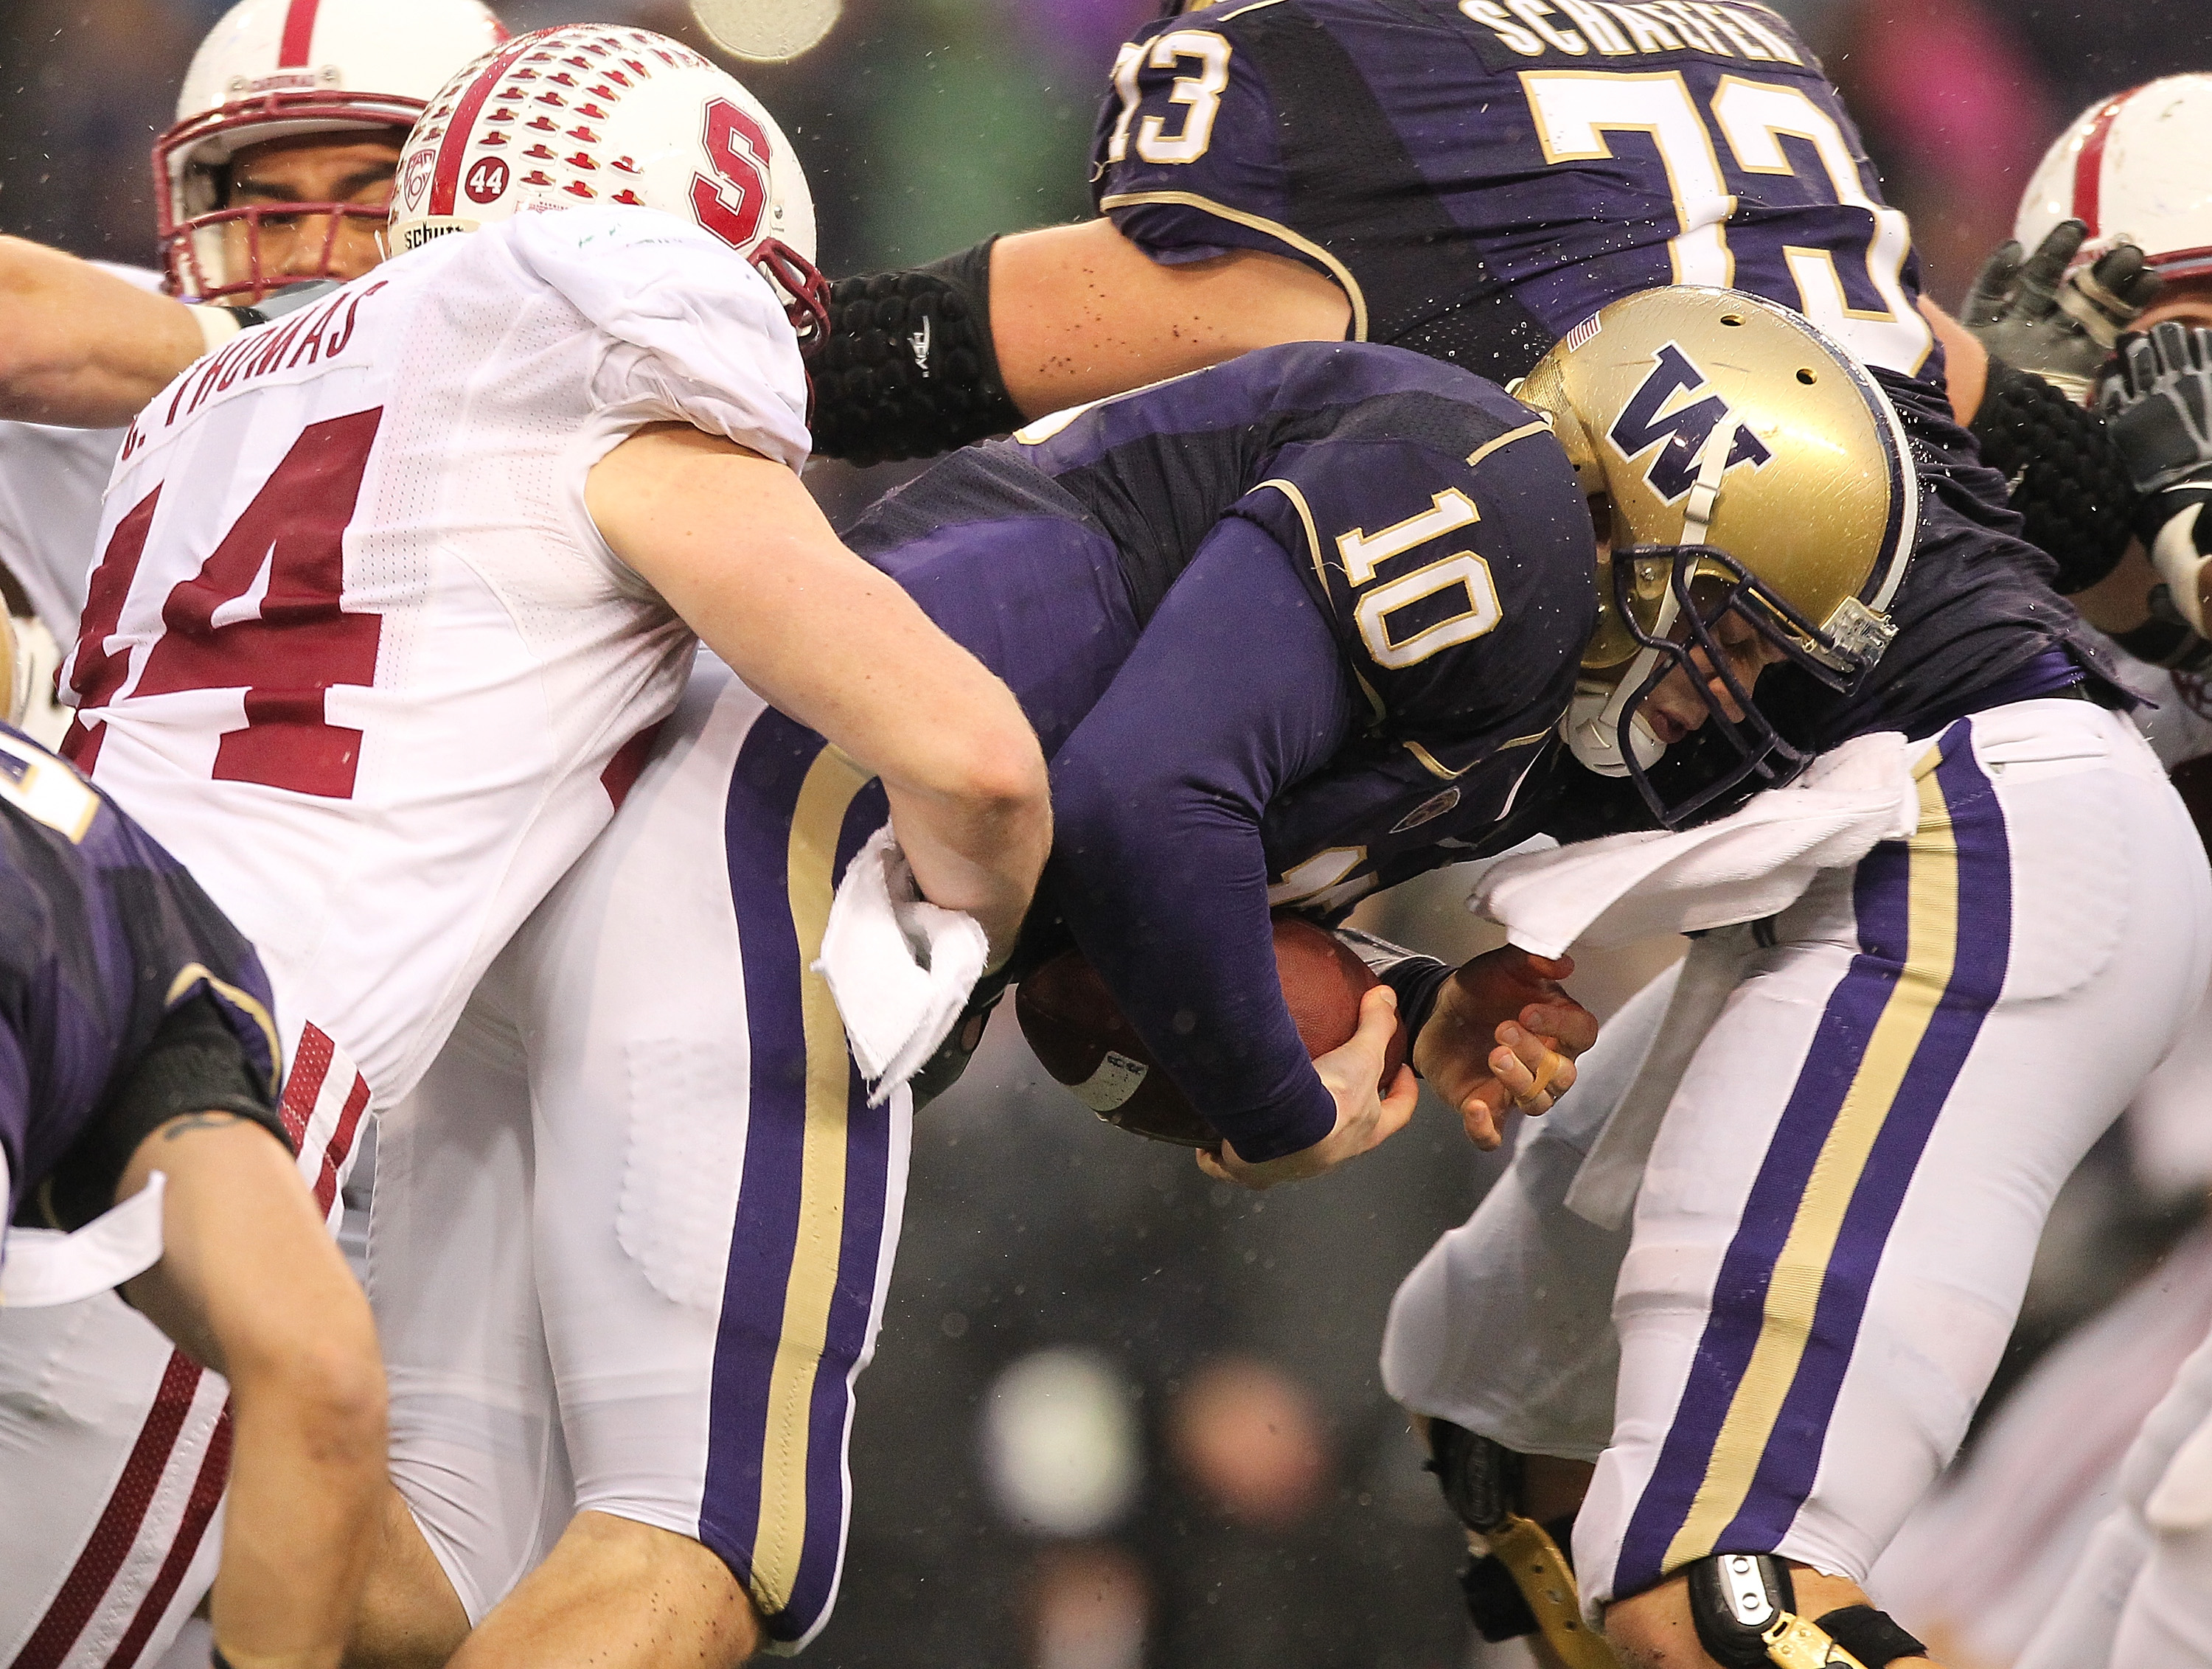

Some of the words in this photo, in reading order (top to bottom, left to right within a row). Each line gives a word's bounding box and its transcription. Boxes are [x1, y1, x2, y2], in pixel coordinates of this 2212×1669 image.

[687, 94, 773, 251] S
[1108, 29, 1234, 165] 73
[470, 165, 504, 195] 44
[1517, 70, 1933, 378] 73
[1606, 338, 1774, 507] W
[1335, 486, 1503, 670] 10
